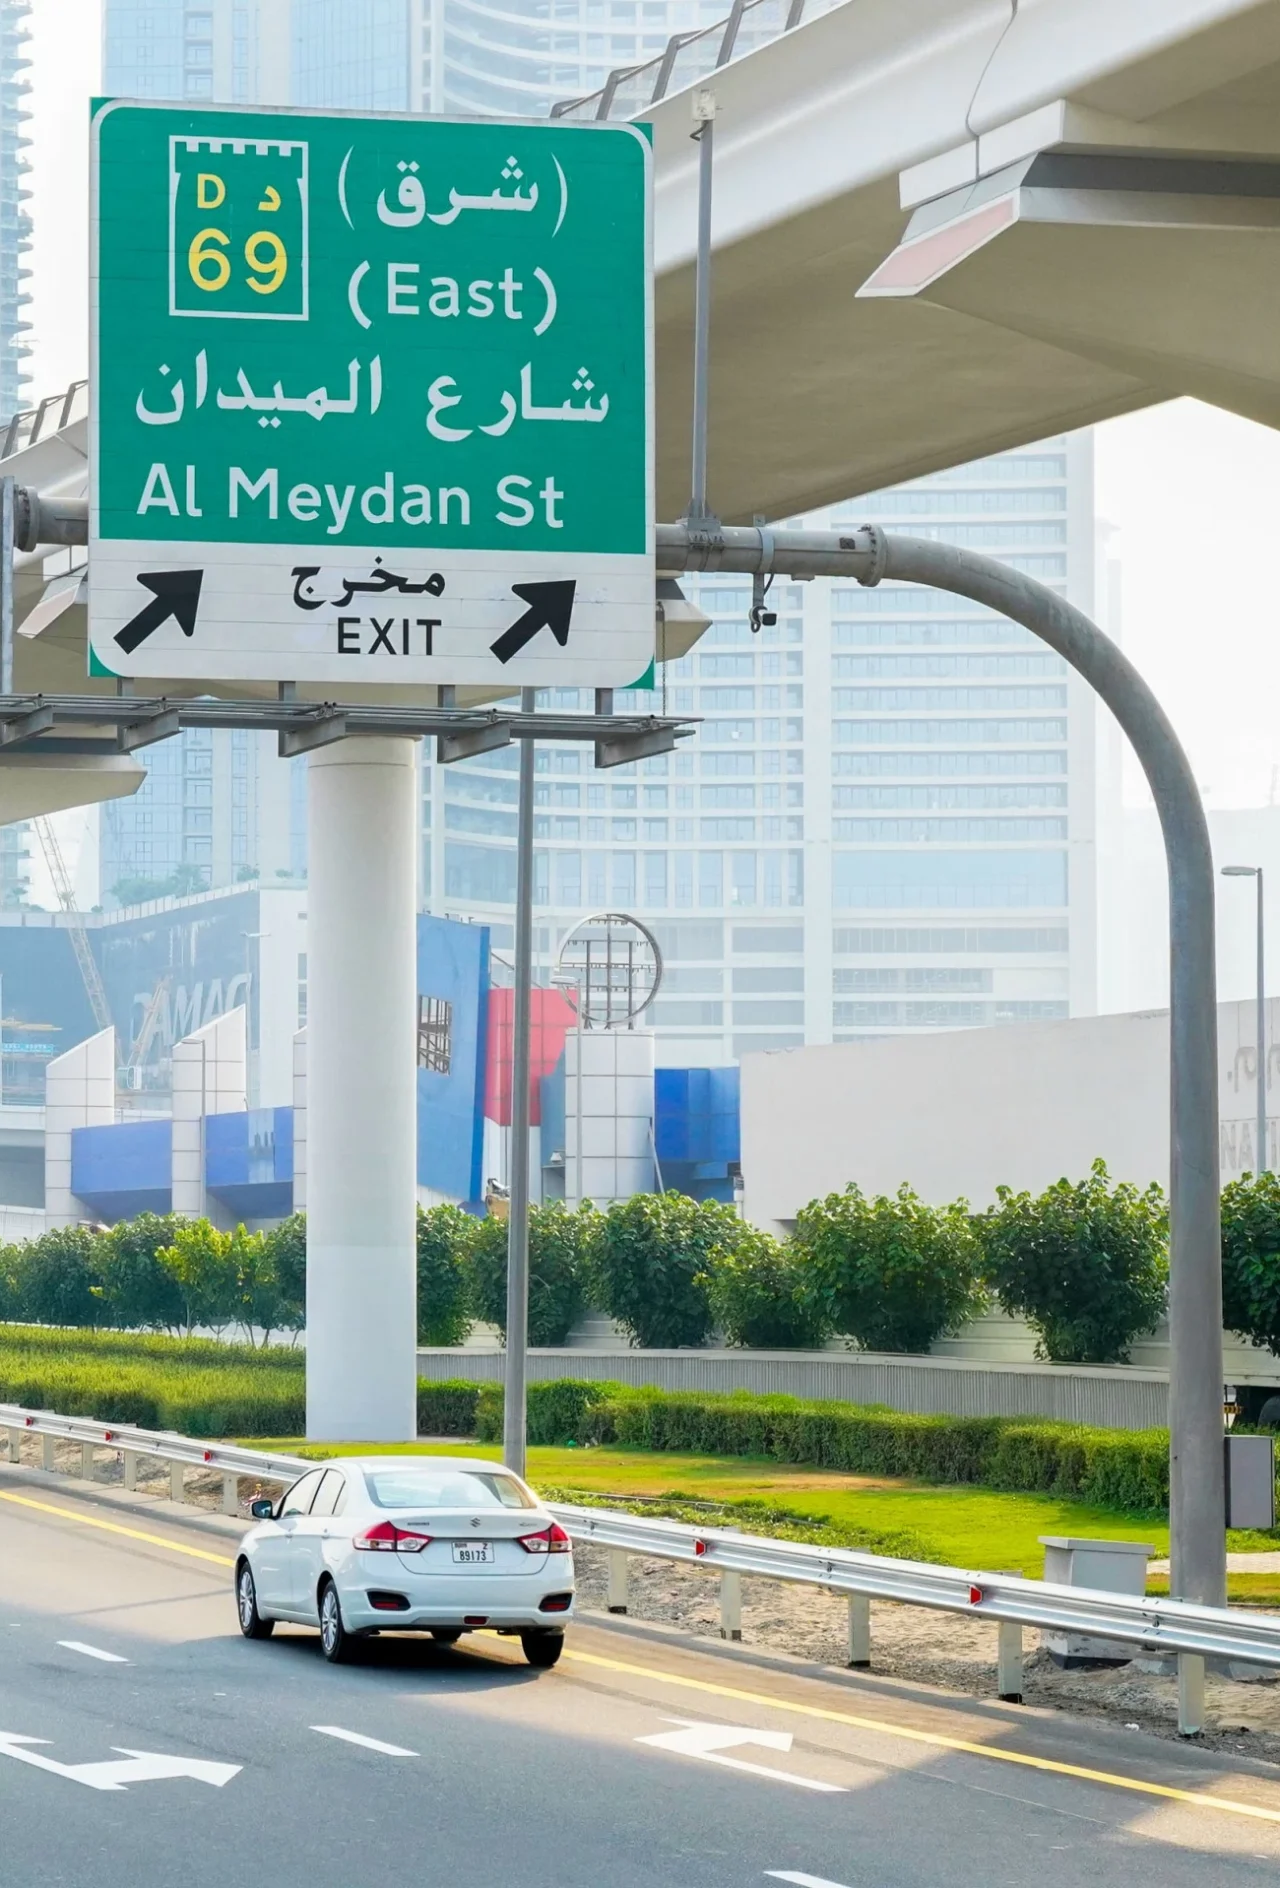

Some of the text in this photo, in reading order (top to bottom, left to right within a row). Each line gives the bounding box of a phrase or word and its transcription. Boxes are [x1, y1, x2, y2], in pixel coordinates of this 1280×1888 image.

[198, 174, 225, 208] D
[259, 186, 281, 211] د
[189, 228, 287, 294] 69
[349, 261, 556, 335] (East)
[136, 350, 608, 441] شارع الميدان
[137, 464, 563, 534] Al Meydan St
[291, 556, 445, 610] مخرج
[338, 617, 441, 655] EXIT
[459, 1550, 487, 1561] 89173
